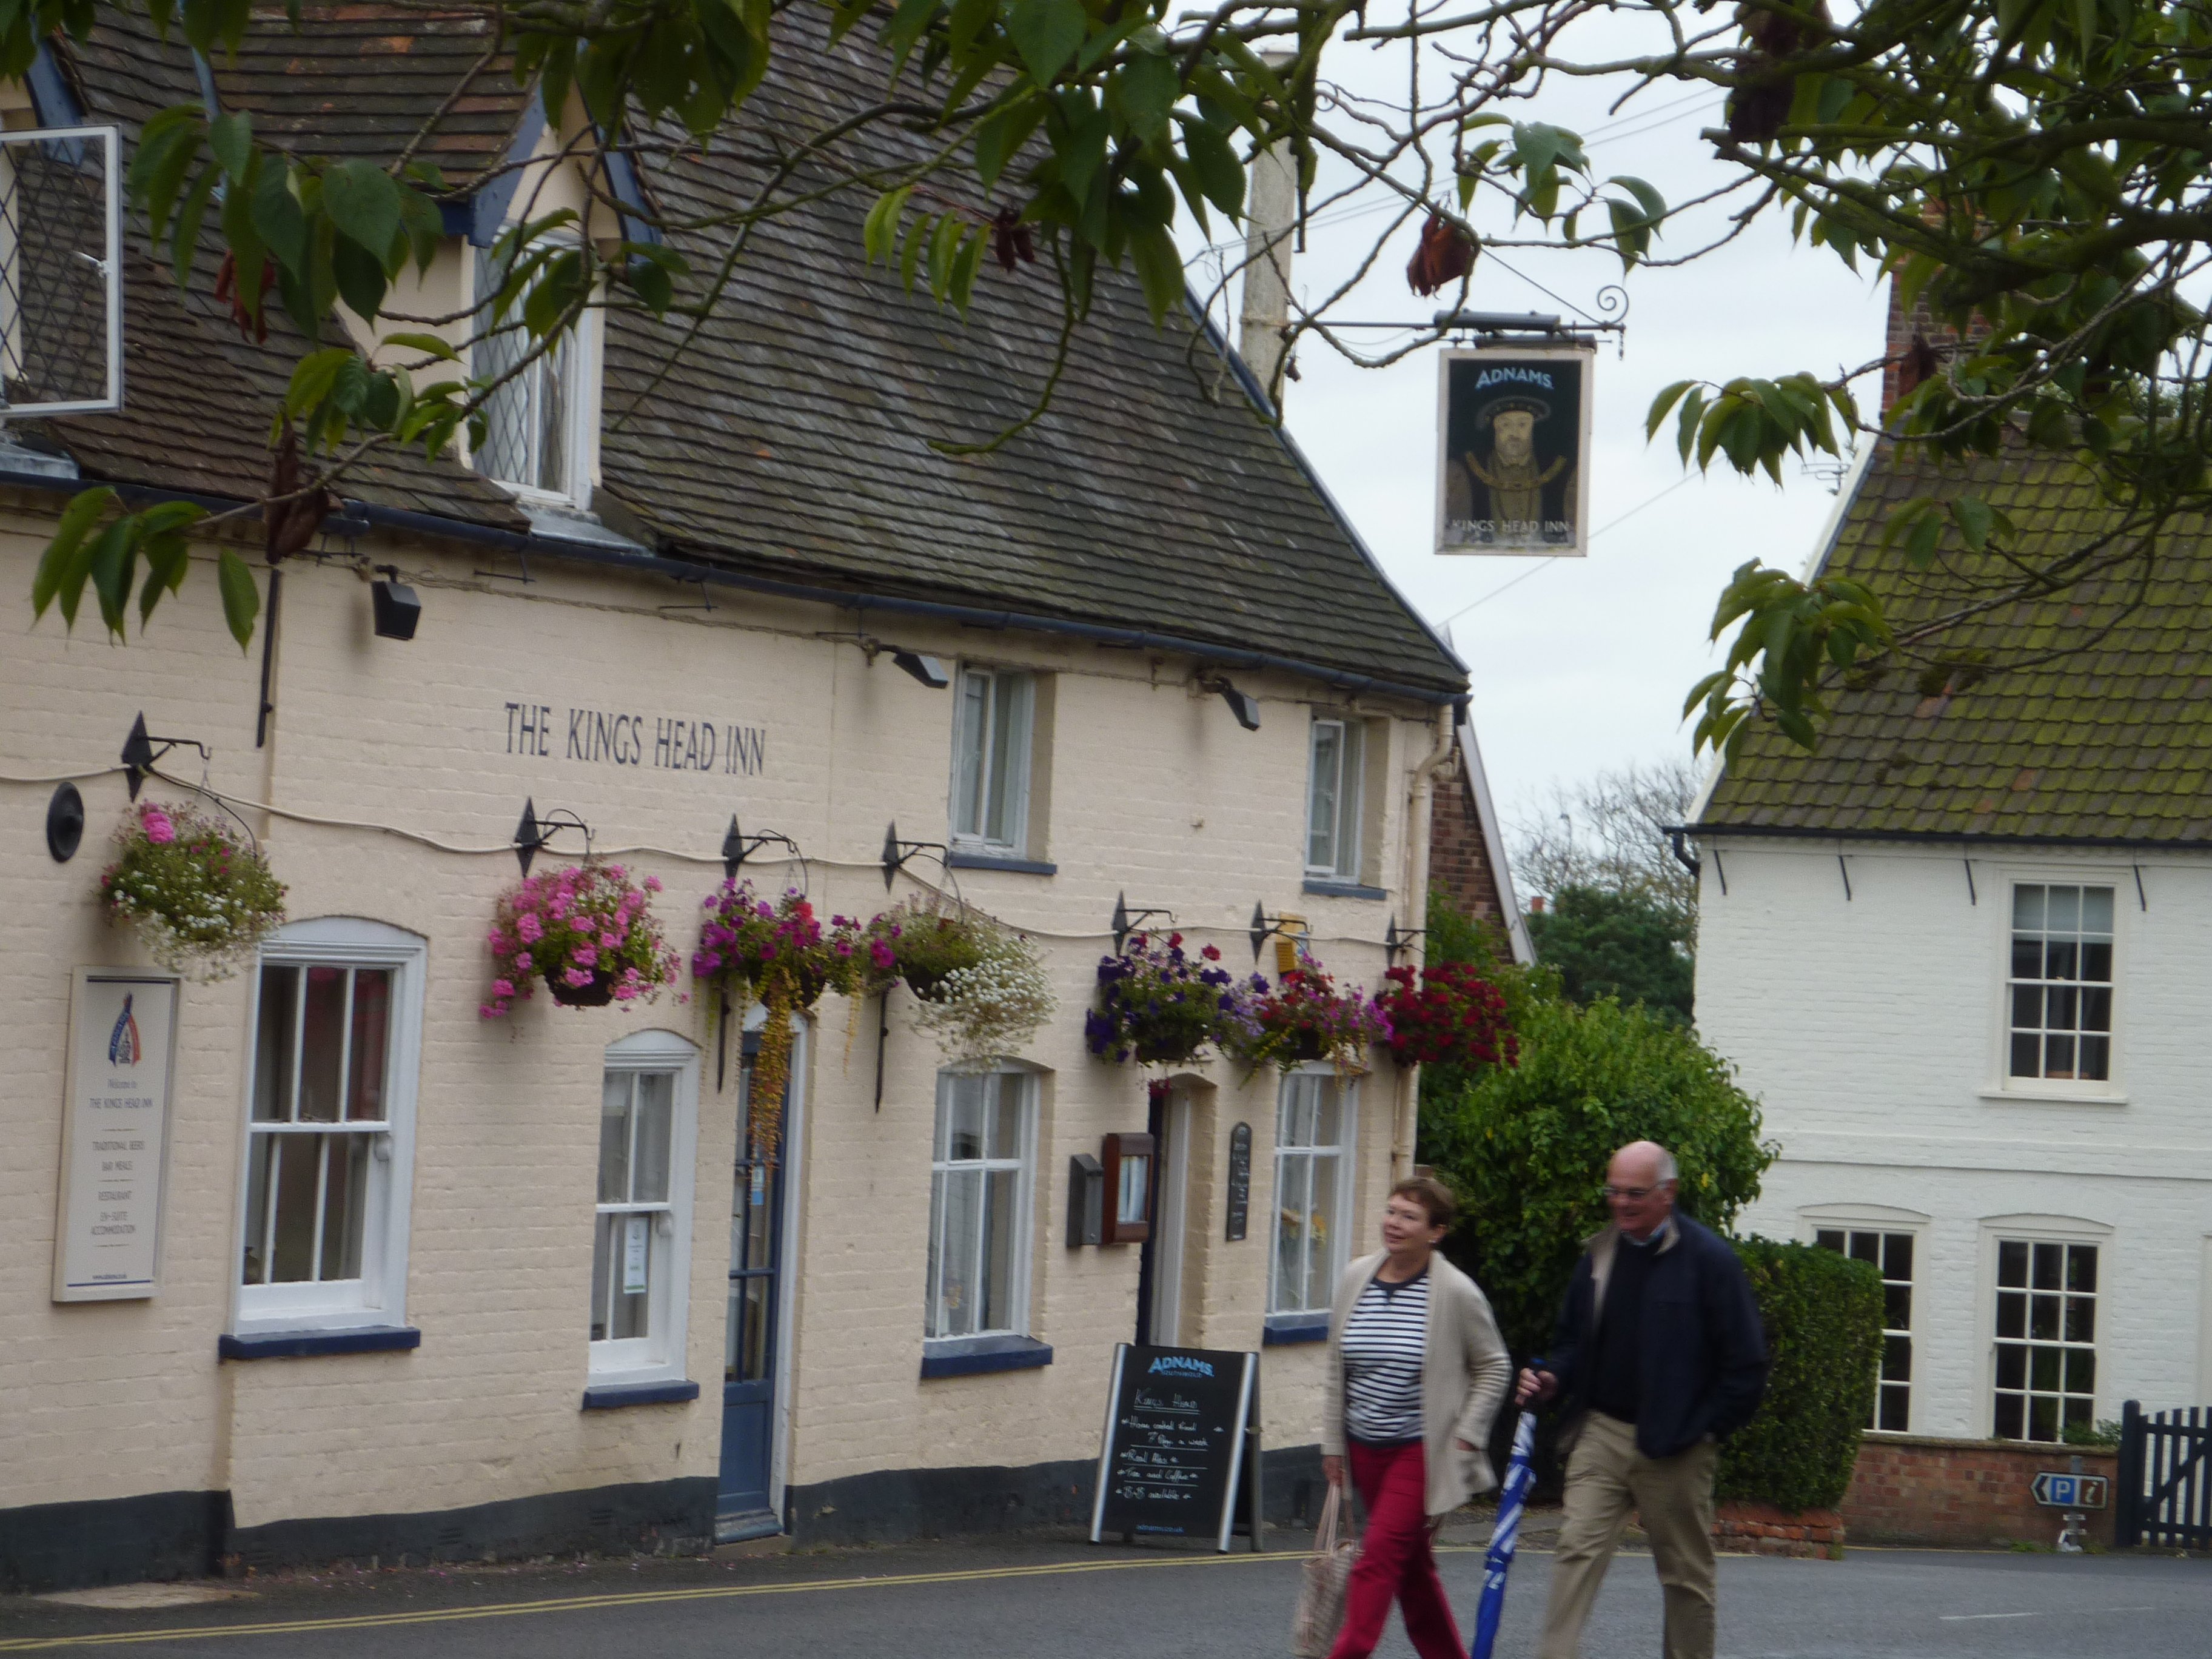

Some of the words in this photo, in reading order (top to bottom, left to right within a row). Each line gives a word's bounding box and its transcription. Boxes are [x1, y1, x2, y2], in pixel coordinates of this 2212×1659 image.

[1475, 367, 1554, 390] ADNAMS
[1451, 519, 1495, 532] KINGS
[1501, 519, 1539, 533] HEAD
[1544, 520, 1570, 533] INN
[504, 702, 550, 756] THE
[566, 708, 643, 765] KINGS
[654, 717, 716, 771] HEAD
[725, 725, 766, 776] INN
[1147, 1356, 1215, 1377] ADNAMS
[1147, 1432, 1159, 1443] 7
[1127, 1449, 1148, 1463] Real
[1125, 1466, 1141, 1478] Tea
[1146, 1469, 1164, 1479] and
[1164, 1469, 1189, 1484] Coffee
[2056, 1480, 2071, 1500] P
